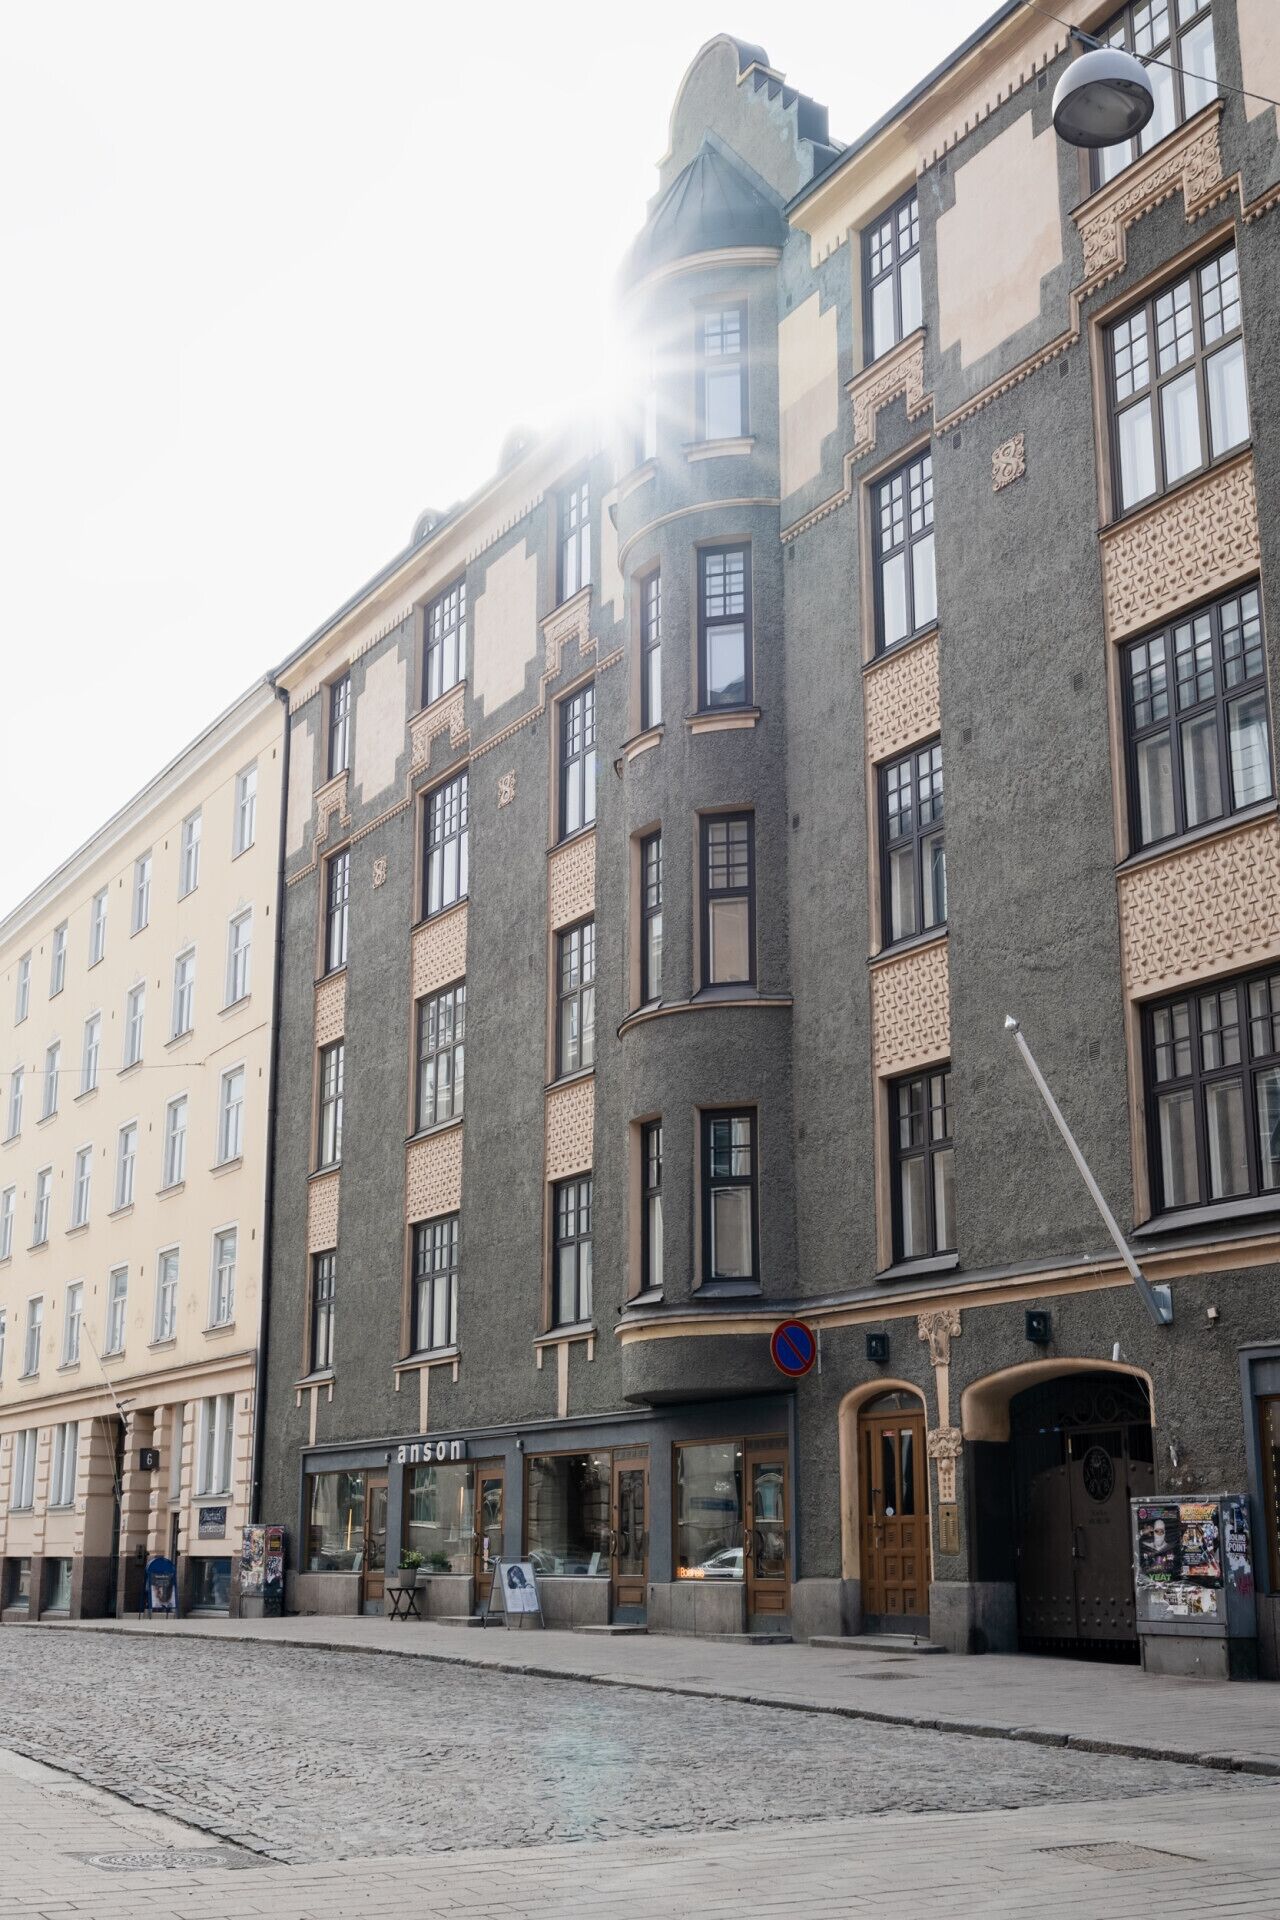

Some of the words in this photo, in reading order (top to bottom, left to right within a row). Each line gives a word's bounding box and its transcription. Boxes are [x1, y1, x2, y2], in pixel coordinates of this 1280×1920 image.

[397, 1440, 464, 1464] anson
[147, 1453, 153, 1465] 6
[1228, 1543, 1247, 1552] POINT
[1149, 1573, 1171, 1581] YEAT
